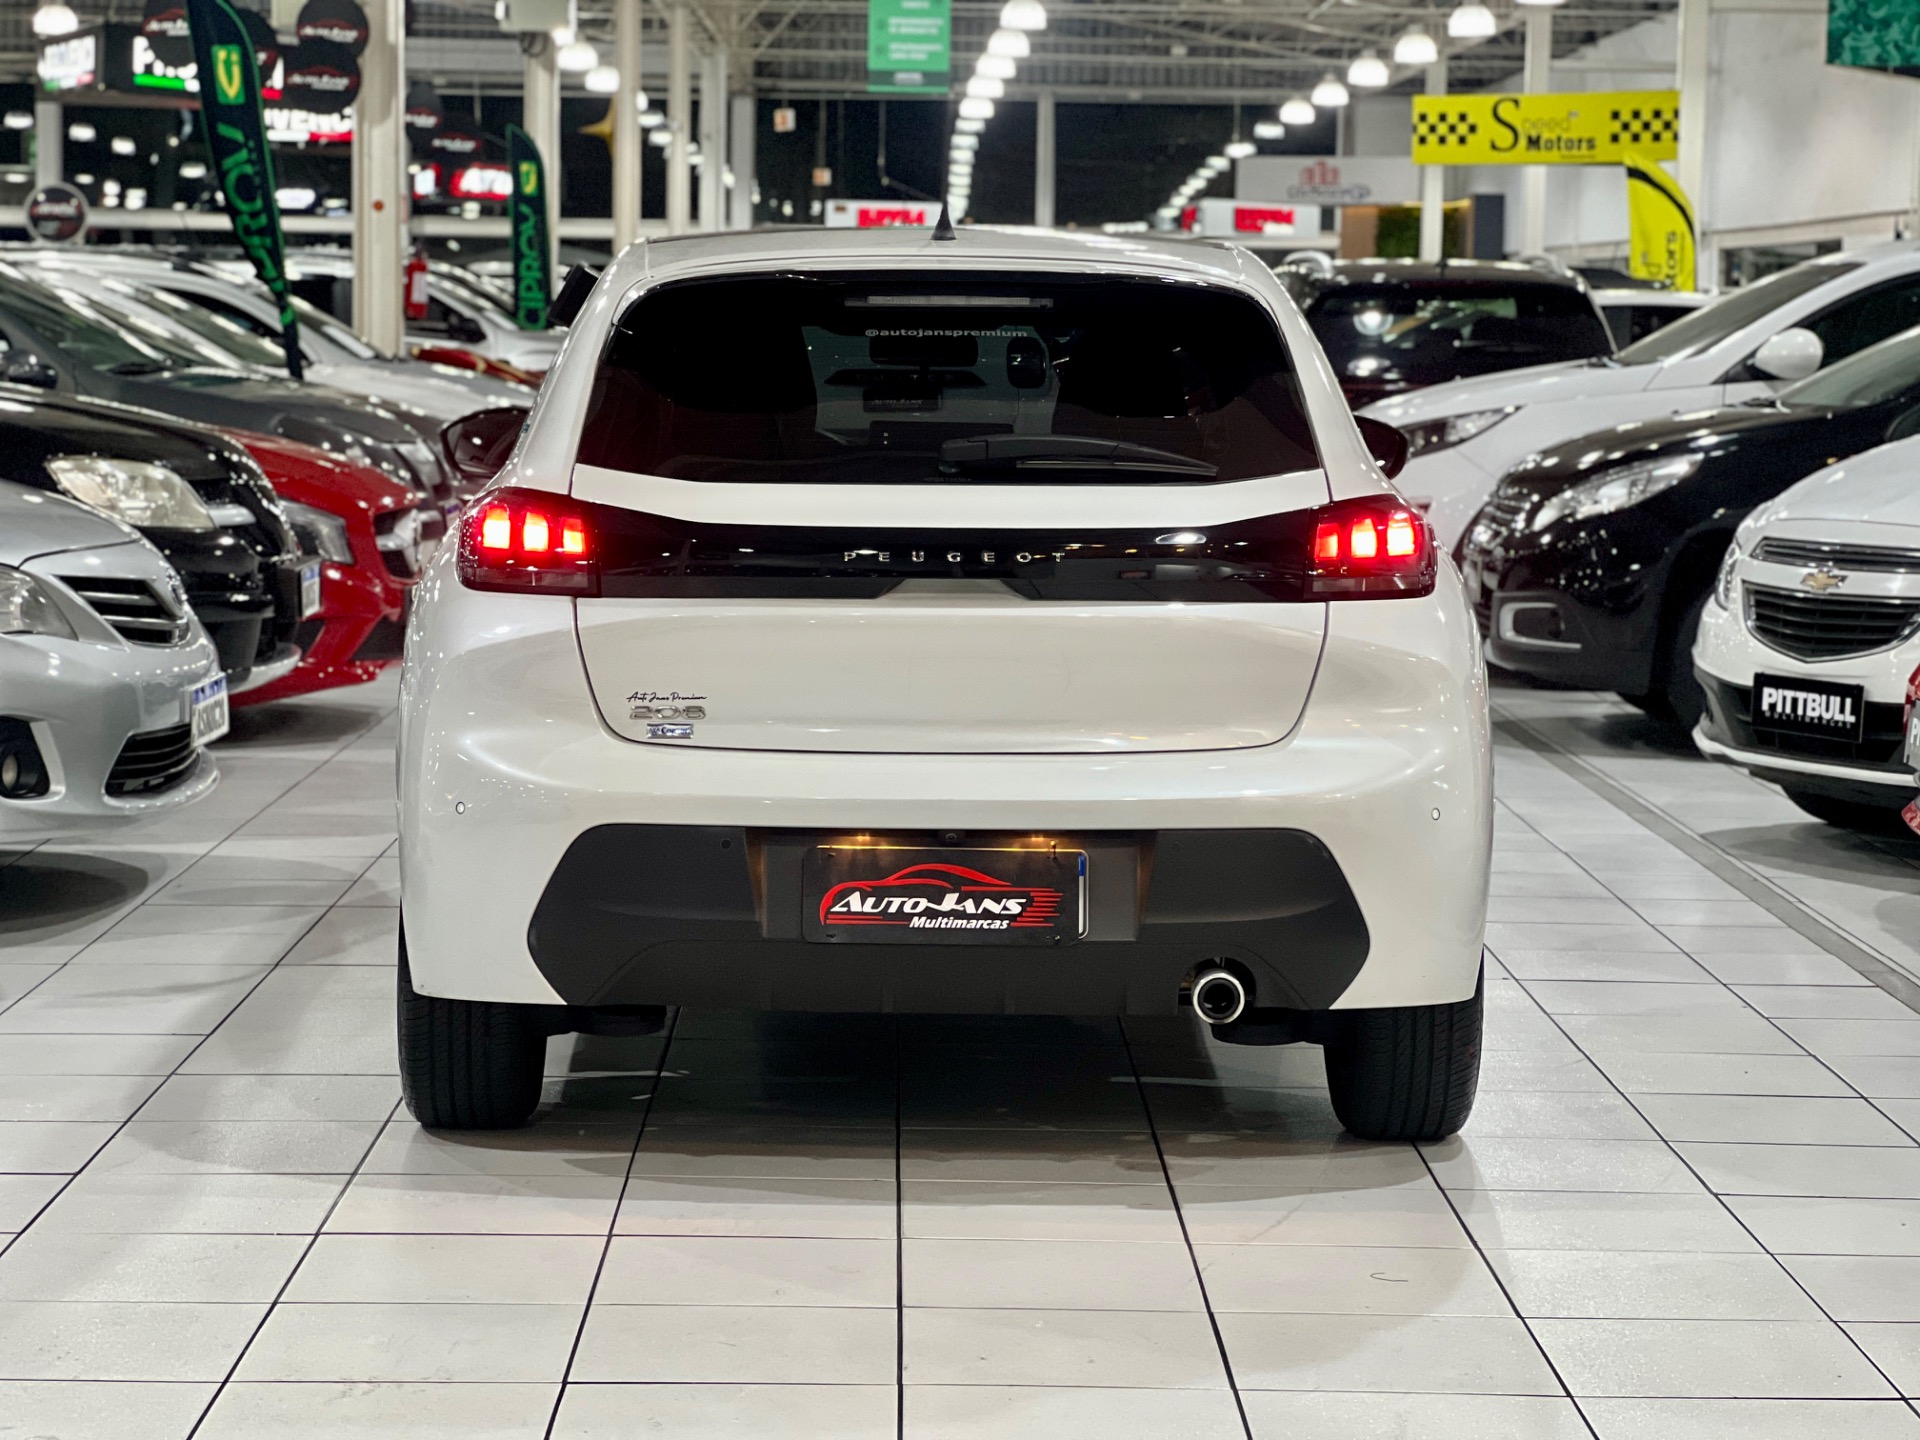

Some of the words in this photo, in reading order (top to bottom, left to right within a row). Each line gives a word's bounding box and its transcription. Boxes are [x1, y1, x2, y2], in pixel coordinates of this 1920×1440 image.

[1526, 134, 1597, 152] Motors
[865, 328, 1028, 338] @autojanspremium
[844, 551, 1065, 563] PEUGEOT
[1762, 686, 1857, 723] PITTBULL
[629, 705, 707, 720] 208
[908, 916, 1010, 929] Multimarcas
